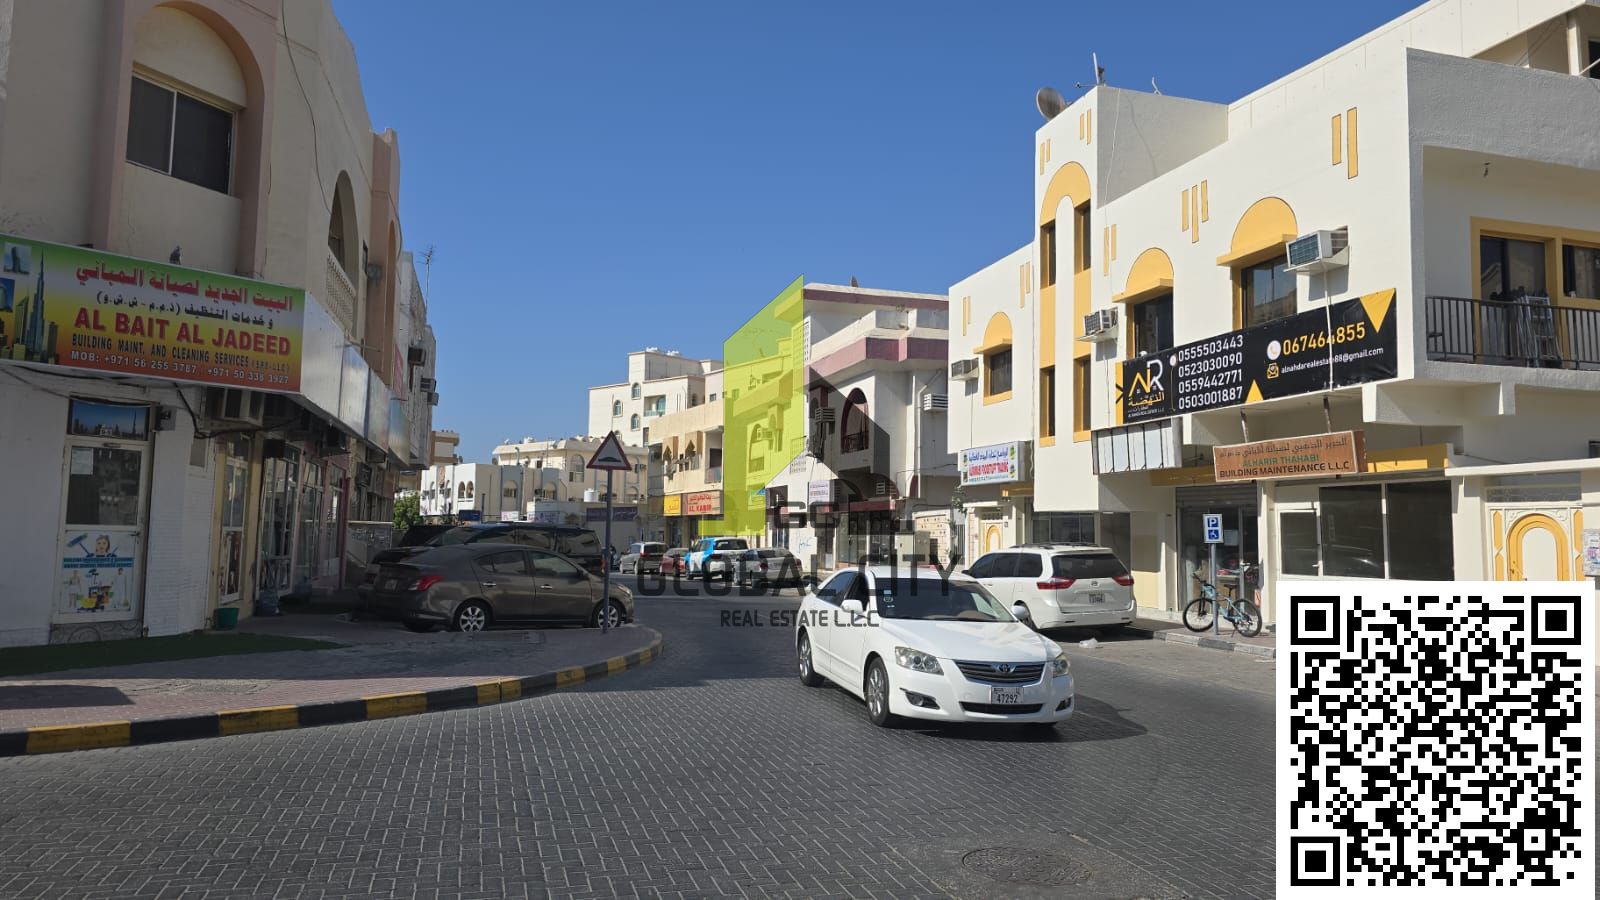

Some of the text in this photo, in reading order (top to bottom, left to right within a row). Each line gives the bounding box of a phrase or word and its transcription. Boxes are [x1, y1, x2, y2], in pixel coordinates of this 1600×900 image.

[76, 260, 293, 313] البيت الجديد لصيانة المباني
[184, 303, 228, 320] التنظيف
[231, 311, 265, 326] خدمات
[74, 307, 291, 356] AL BAIT AL JADEED
[72, 333, 112, 350] BUILDING
[151, 344, 167, 357] AND
[172, 346, 209, 362] CLEANING
[215, 352, 249, 367] SERVICES
[1178, 334, 1243, 362] 0555503443
[1281, 347, 1384, 374] alnahdarealesta88@gmail.com
[71, 350, 99, 362] MOB:
[104, 355, 129, 365] +971
[151, 360, 169, 370] 255
[207, 367, 229, 377] +971
[234, 370, 245, 379] 50
[1178, 352, 1242, 378] 0523030090
[1178, 369, 1242, 394] 0559442771
[1178, 386, 1243, 410] 0503001887
[1219, 461, 1350, 478] BUILDING MAINTENANCE L.L.C
[1280, 454, 1319, 465] THAHABI
